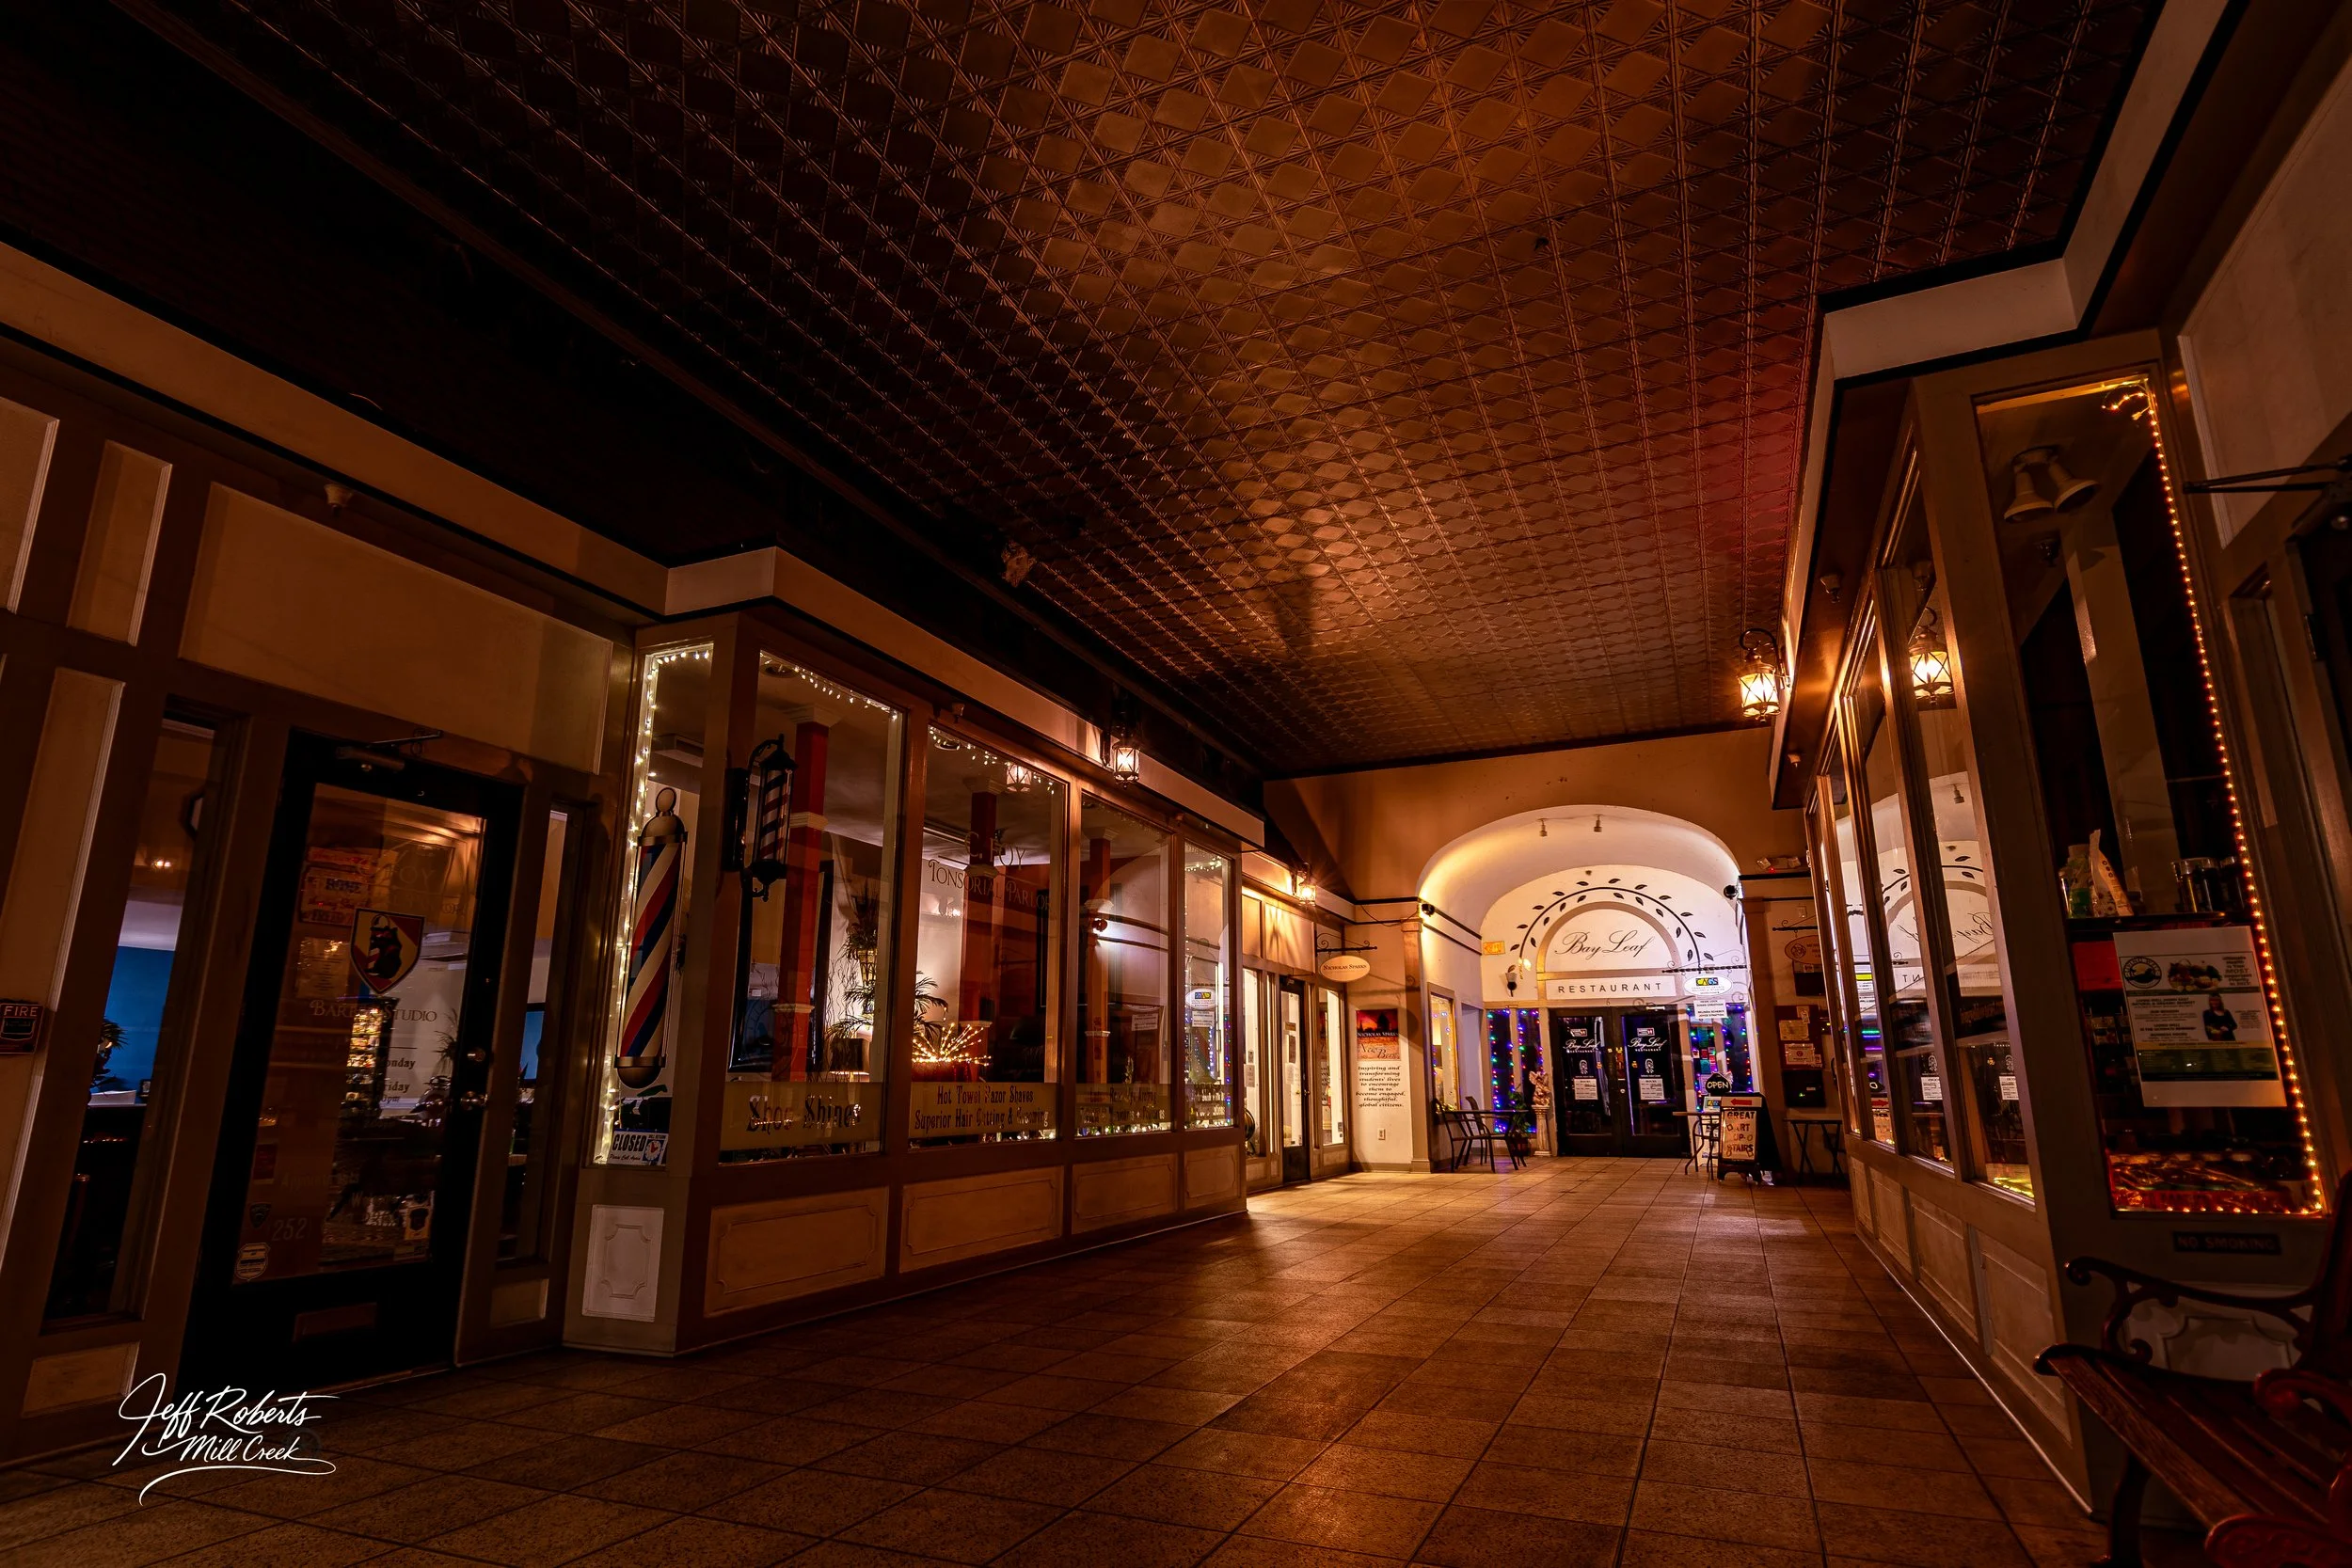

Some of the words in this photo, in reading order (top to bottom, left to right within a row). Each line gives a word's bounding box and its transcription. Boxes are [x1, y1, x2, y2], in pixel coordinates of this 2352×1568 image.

[990, 837, 1025, 871] FOY
[1555, 931, 1602, 960] Bay
[1603, 929, 1655, 958] Leaf
[1558, 983, 1662, 993] RESTAURANT
[4, 1006, 39, 1017] FIRE
[310, 999, 377, 1019] BARB
[384, 1003, 437, 1022] STUDIO
[1563, 1038, 1583, 1050] Bay
[1628, 1037, 1647, 1050] Bay
[1646, 1037, 1667, 1050] Leaf
[379, 1059, 416, 1069] onday
[381, 1082, 410, 1093] riday
[1707, 1081, 1729, 1089] OPEN
[937, 1085, 952, 1104] Hot
[957, 1085, 980, 1104] Towel
[984, 1085, 1007, 1104] Razor
[1009, 1085, 1034, 1104] Shaves
[746, 1094, 793, 1135] Shoe
[914, 1110, 951, 1133] Superior
[955, 1108, 974, 1128] Hair
[976, 1108, 1005, 1129] Cutting
[1008, 1107, 1013, 1125] &
[1727, 1111, 1755, 1119] GREAT
[612, 1133, 647, 1152] CLOSED
[1726, 1144, 1754, 1152] STAIRS
[2177, 1236, 2199, 1248] NO
[2204, 1236, 2277, 1251] SMOKING
